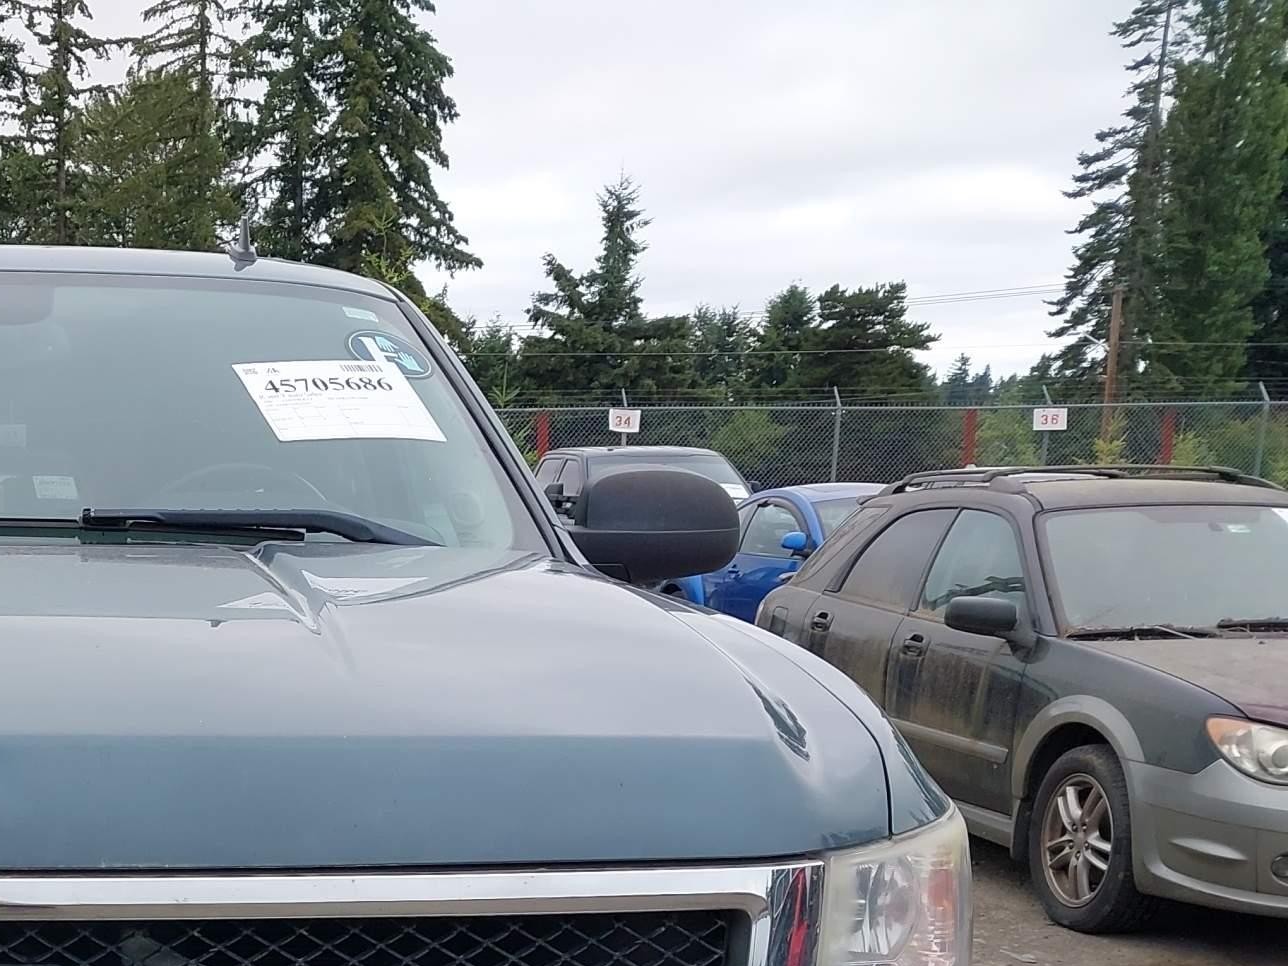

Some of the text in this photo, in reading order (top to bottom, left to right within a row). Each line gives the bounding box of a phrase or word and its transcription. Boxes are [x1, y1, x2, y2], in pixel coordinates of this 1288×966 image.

[265, 377, 393, 393] 45705686
[615, 415, 631, 427] 34
[1041, 414, 1059, 425] 36
